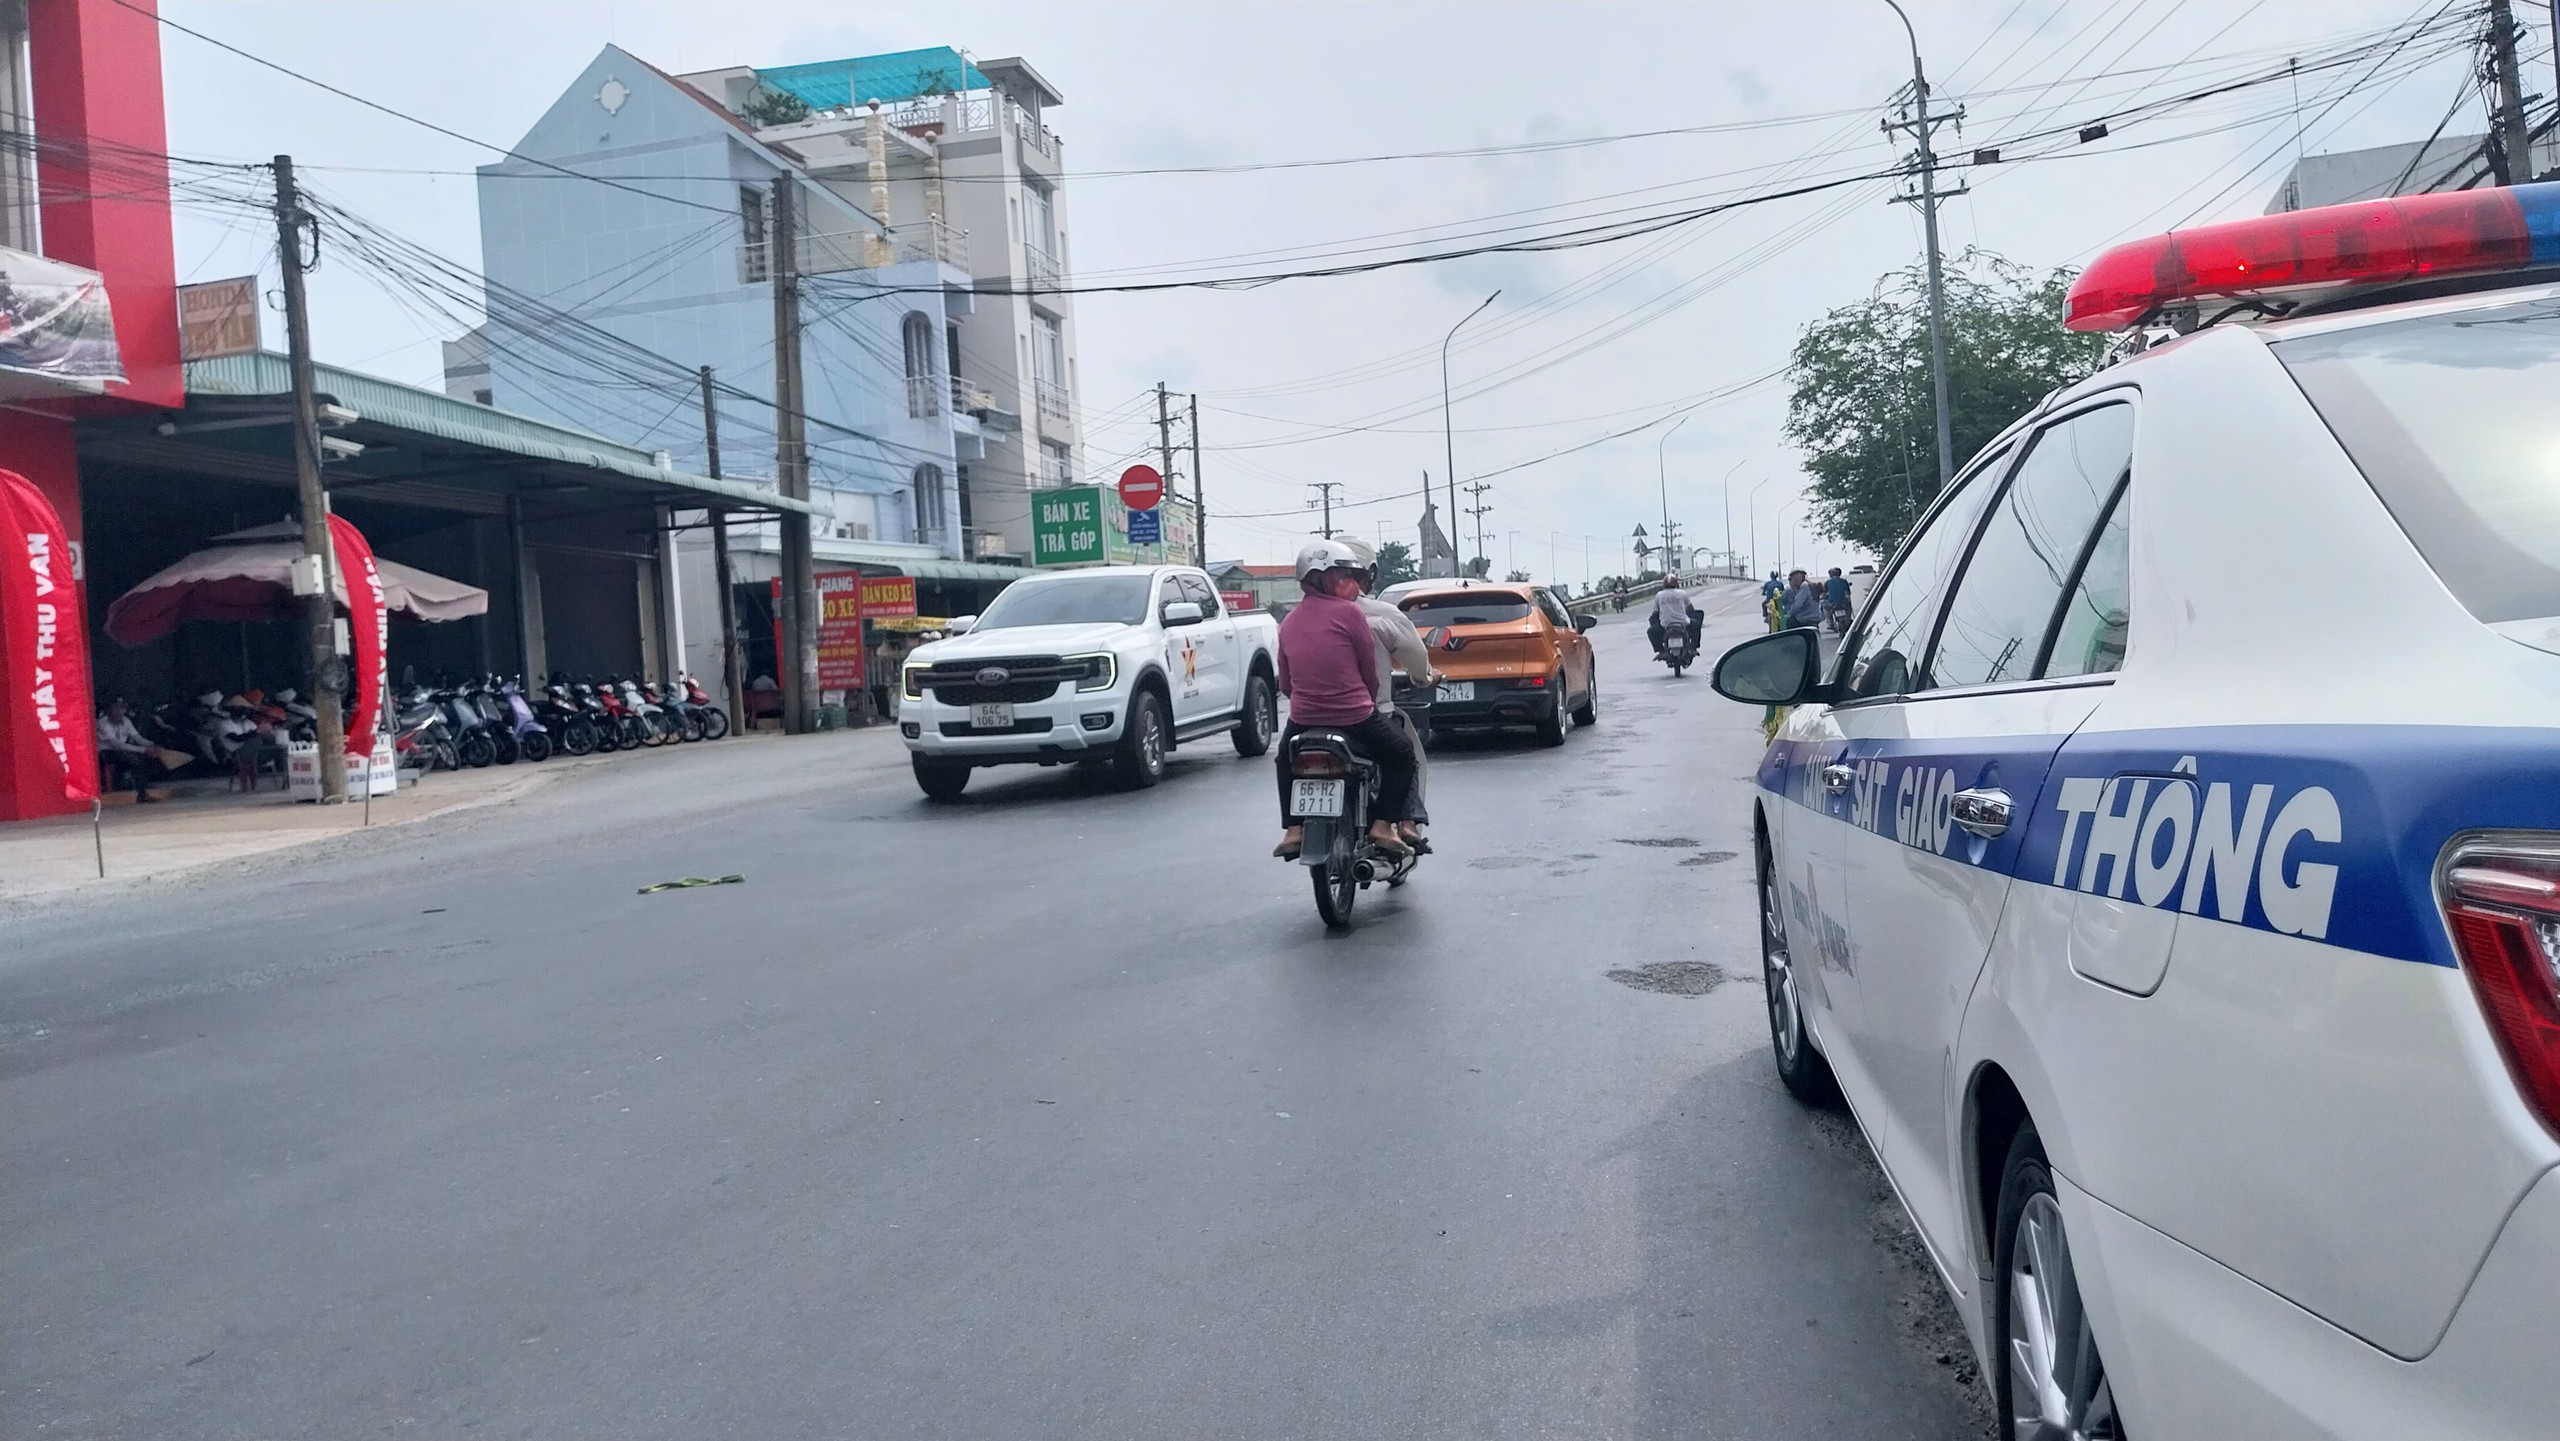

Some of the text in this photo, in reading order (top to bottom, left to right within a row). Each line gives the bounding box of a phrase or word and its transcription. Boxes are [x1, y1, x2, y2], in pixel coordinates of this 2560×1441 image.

[1043, 500, 1069, 523] BÁN
[1073, 501, 1091, 521] XE
[1041, 526, 1096, 552] TRẢ GÓP
[821, 576, 854, 592] GIANG
[900, 583, 913, 602] XE
[839, 598, 856, 617] XE
[37, 604, 57, 660] THU
[31, 667, 60, 731] MÁY
[982, 704, 1000, 715] 64C
[1300, 782, 1336, 796] 66-H2
[1299, 798, 1333, 812] 8711
[1852, 747, 1889, 834] SÁT
[1895, 765, 1955, 855] GIAO
[2053, 755, 2342, 940] THÔNG
